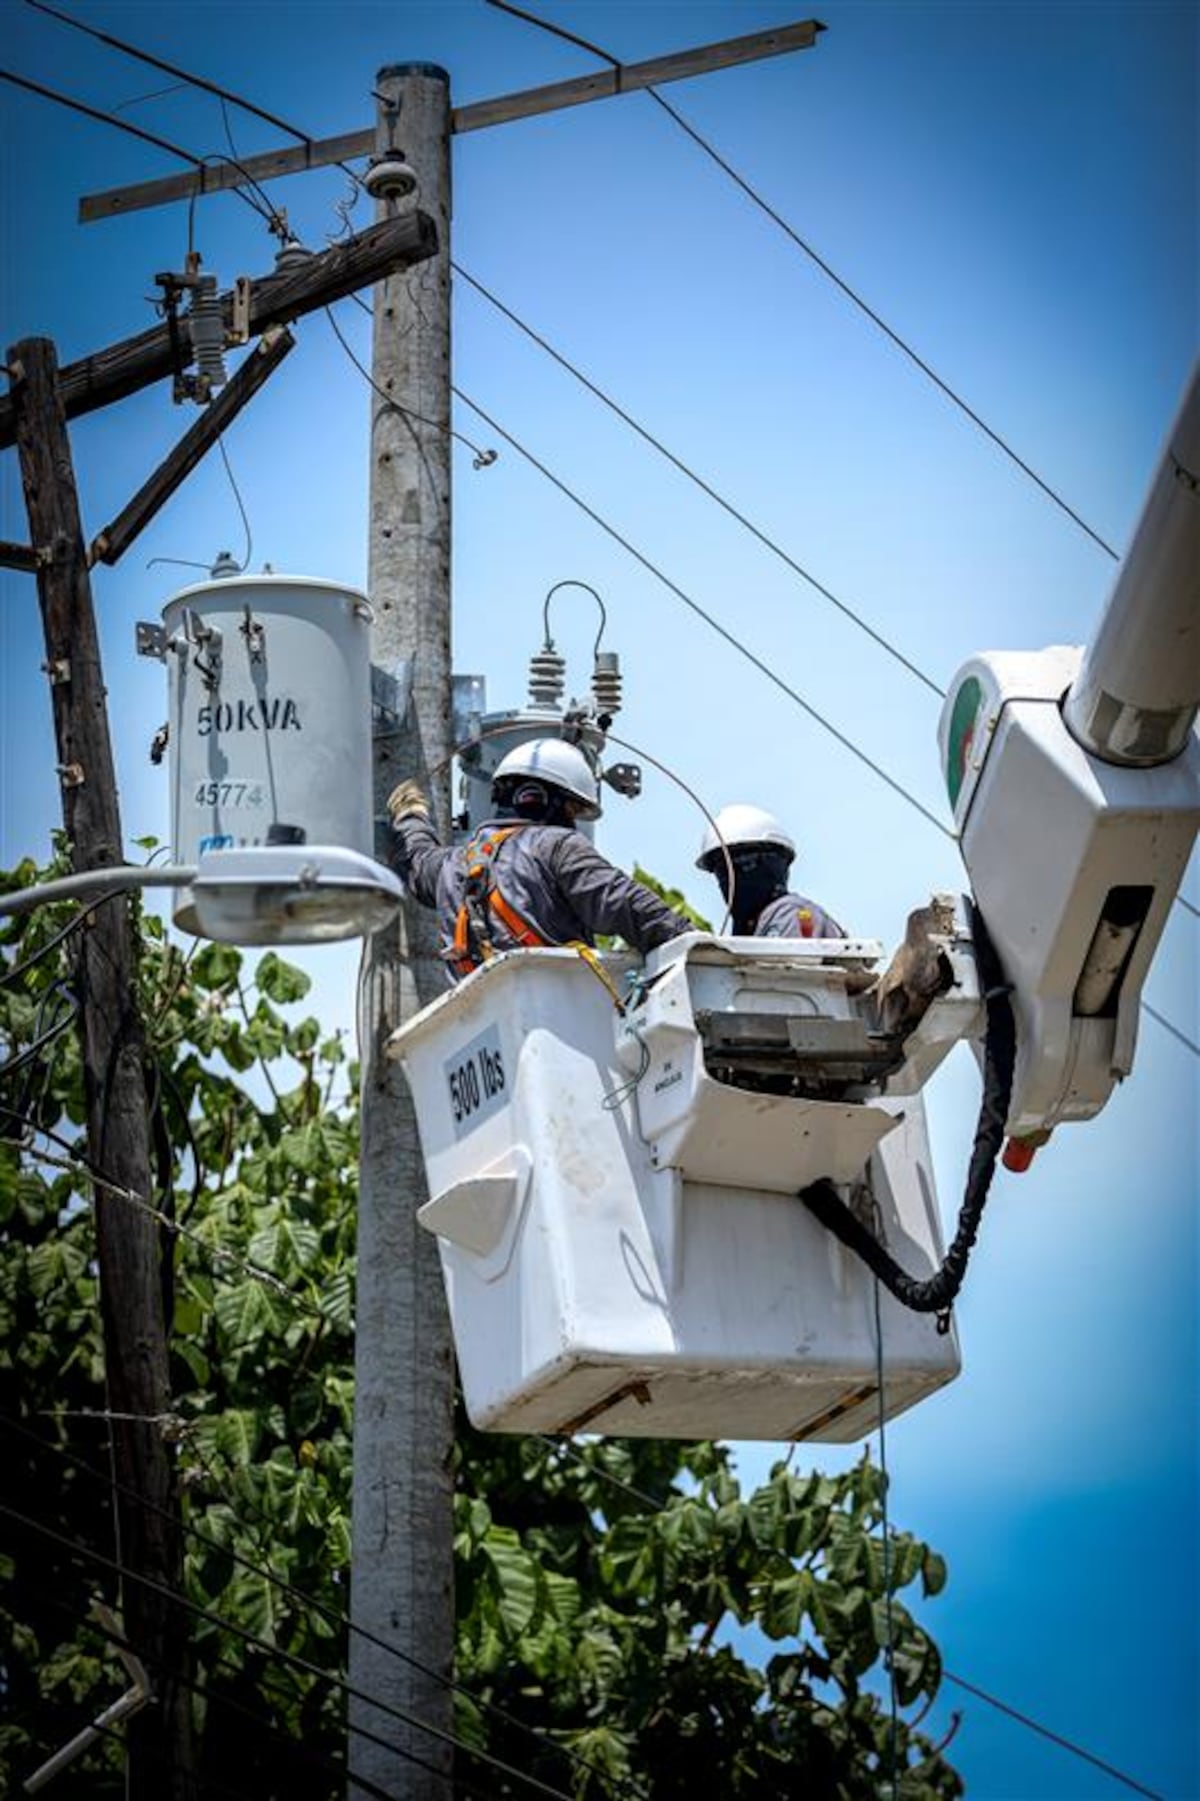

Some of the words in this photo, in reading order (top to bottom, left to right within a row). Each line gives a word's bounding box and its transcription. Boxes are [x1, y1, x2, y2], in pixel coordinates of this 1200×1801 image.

[198, 699, 301, 736] 50KVA
[449, 1059, 480, 1123] 500
[478, 1047, 505, 1100] lbs
